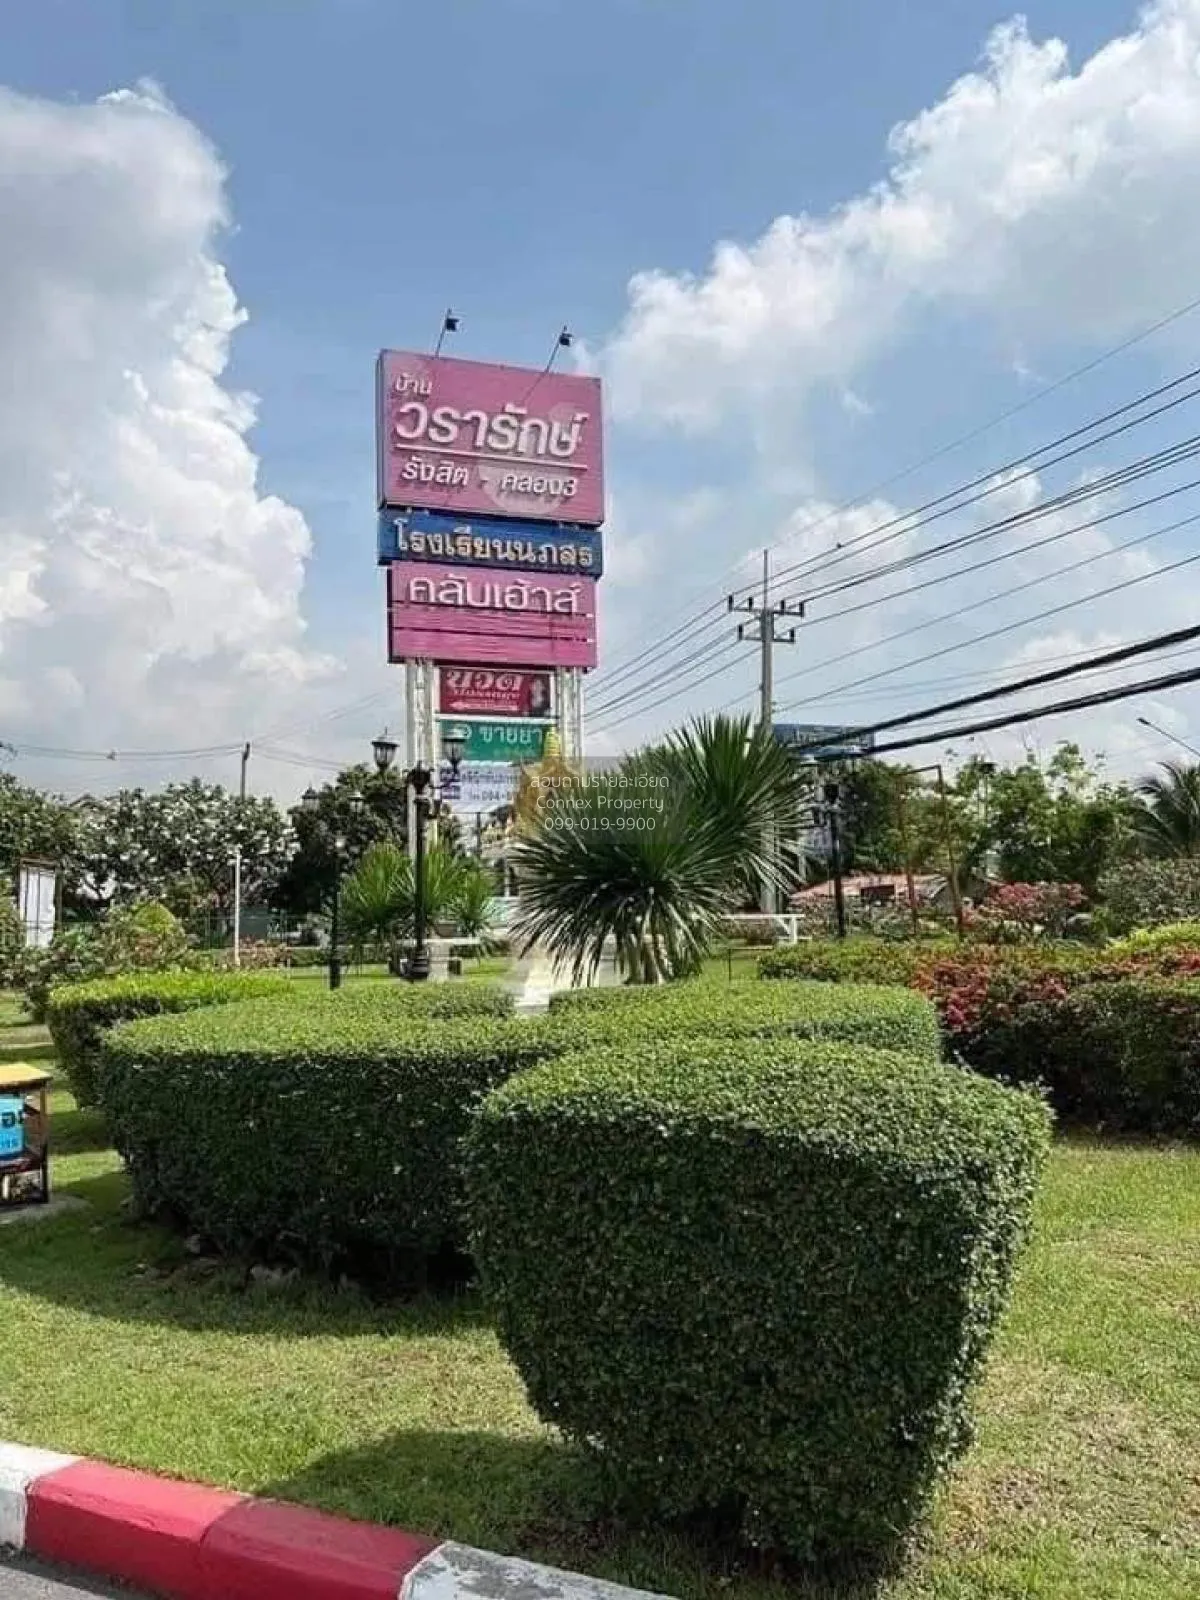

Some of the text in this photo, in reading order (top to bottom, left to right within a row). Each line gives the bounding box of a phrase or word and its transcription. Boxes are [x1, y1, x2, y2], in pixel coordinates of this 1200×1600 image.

[395, 372, 433, 396] บ้าน
[396, 402, 590, 458] วรารักษ์
[401, 456, 469, 487] รังสิต
[501, 472, 578, 497] คลอง3
